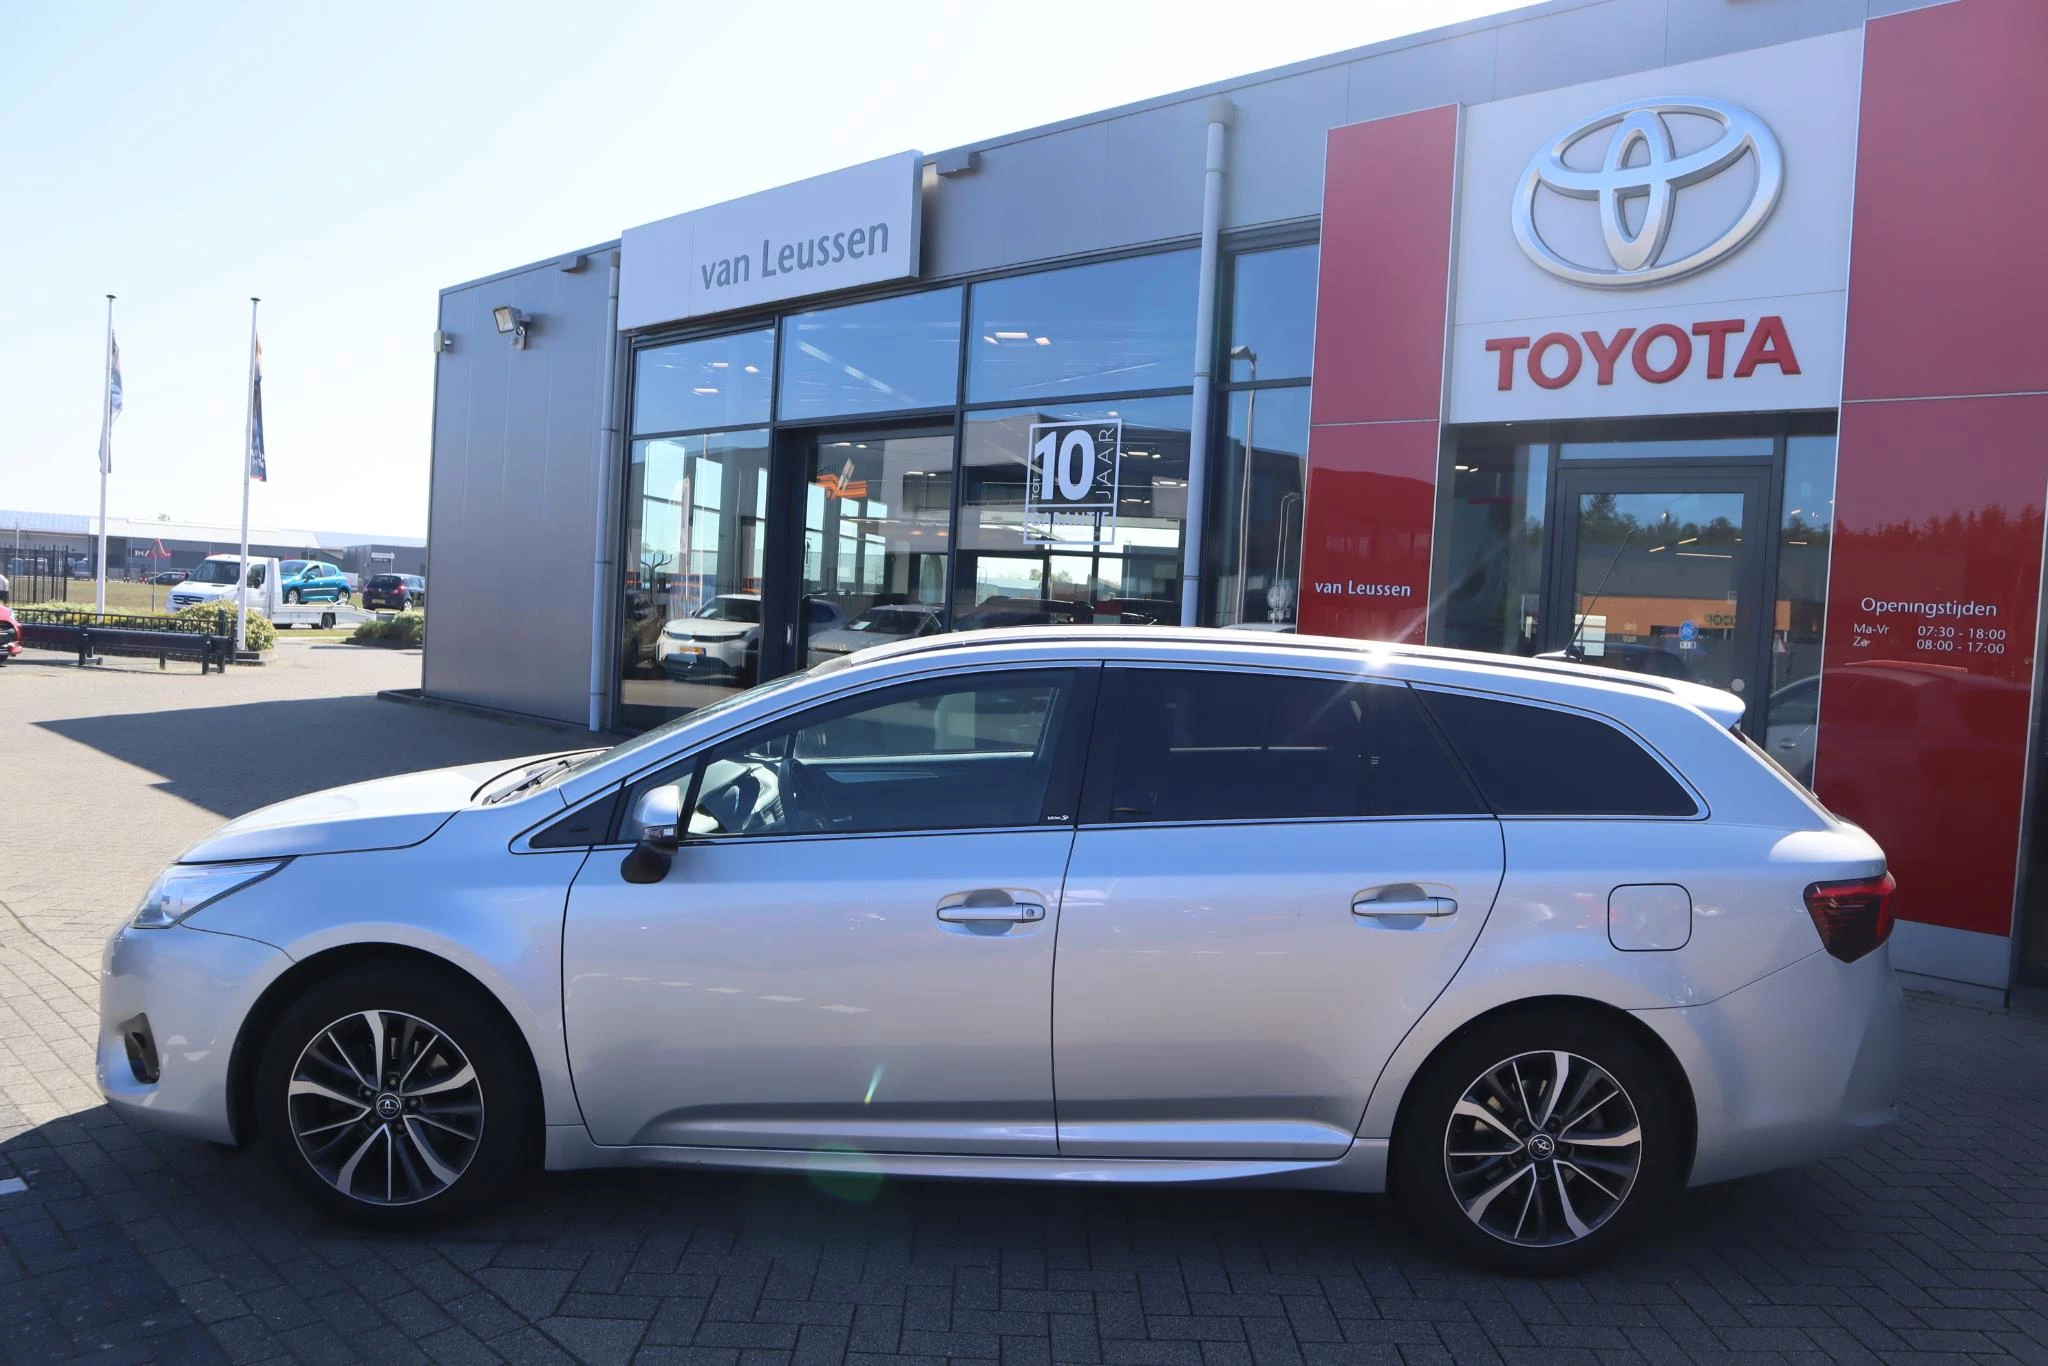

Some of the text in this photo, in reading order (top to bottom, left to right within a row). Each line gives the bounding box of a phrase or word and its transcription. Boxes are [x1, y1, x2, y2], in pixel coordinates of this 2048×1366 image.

[702, 222, 889, 290] van Leussen
[1485, 315, 1802, 391] TOYOTA
[1034, 429, 1095, 500] 10
[1095, 427, 1114, 499] JAAR
[1032, 478, 1041, 500] TOT
[1314, 579, 1411, 597] van Leussen
[1861, 597, 1998, 619] Openingstijden
[1853, 623, 1889, 635] Ma-Vr
[1917, 625, 1955, 638] 07:30
[1968, 628, 2006, 640] 18:00
[1916, 639, 1954, 651] 08:00
[1967, 642, 2005, 654] 17:00
